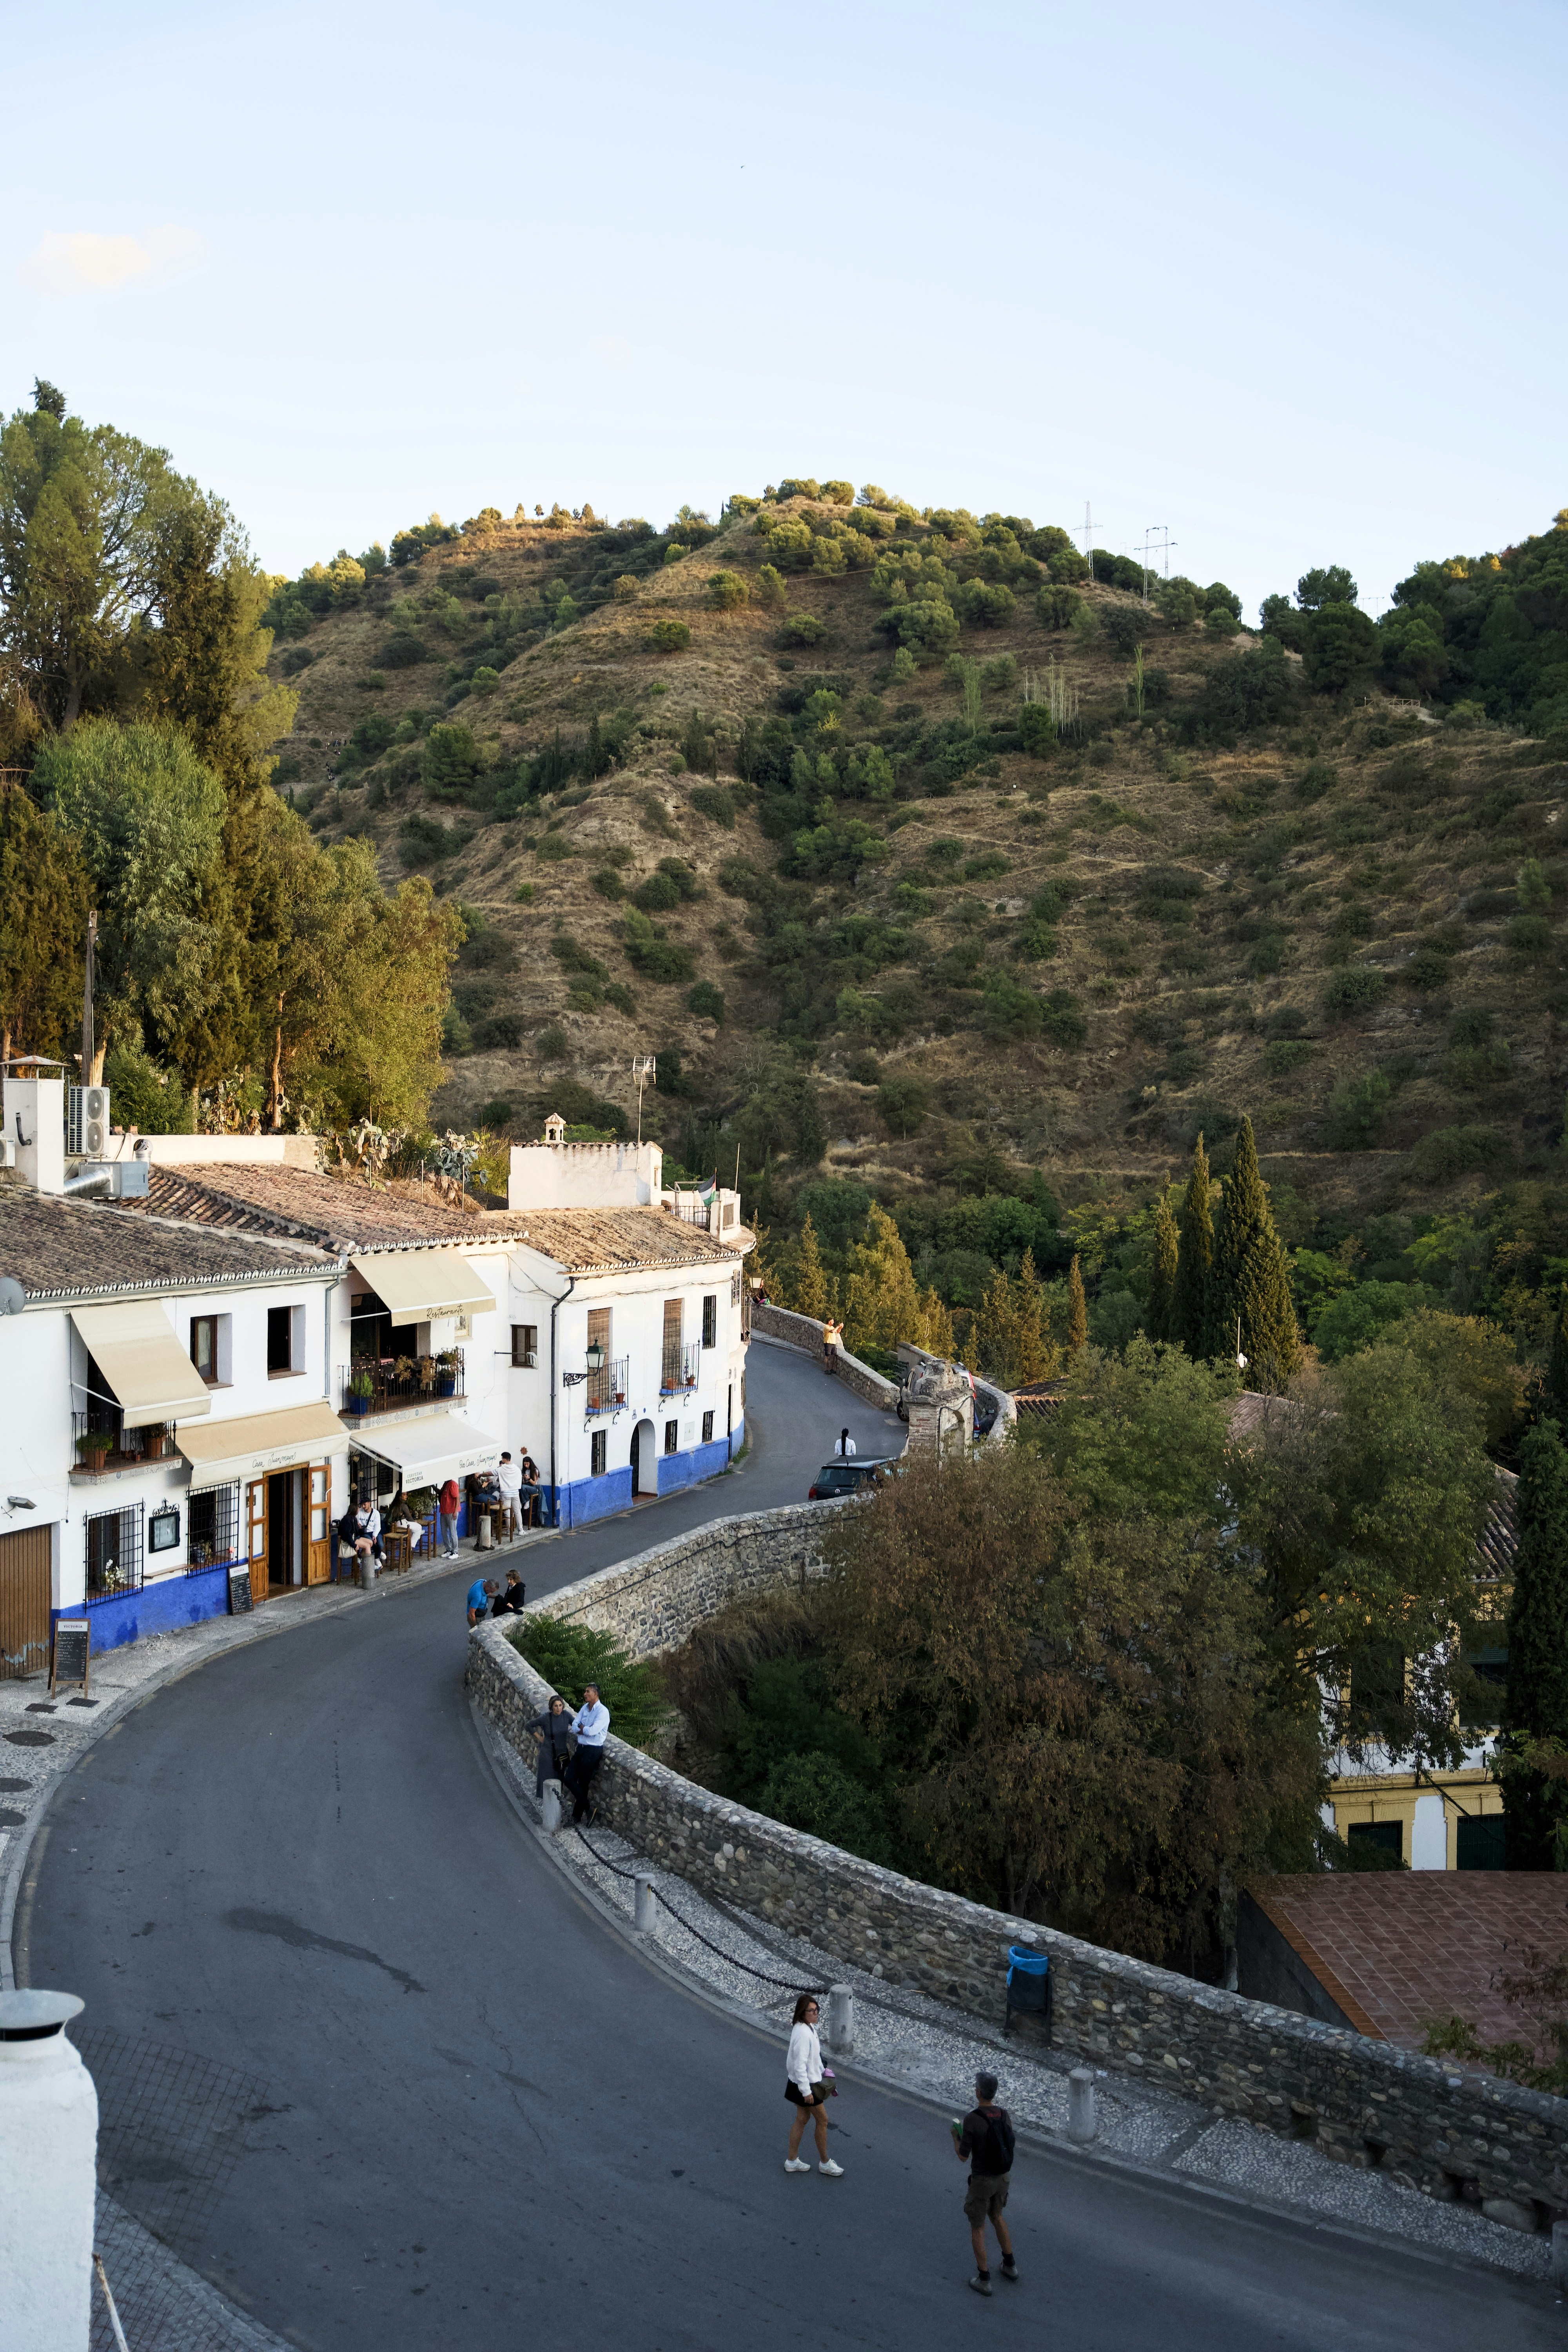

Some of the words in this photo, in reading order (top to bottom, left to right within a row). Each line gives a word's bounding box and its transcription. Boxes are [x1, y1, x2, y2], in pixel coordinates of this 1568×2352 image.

[426, 1304, 464, 1319] Restaurante
[252, 1459, 265, 1468] Casa
[466, 1459, 475, 1467] Casa
[406, 1475, 423, 1484] VICTORIA
